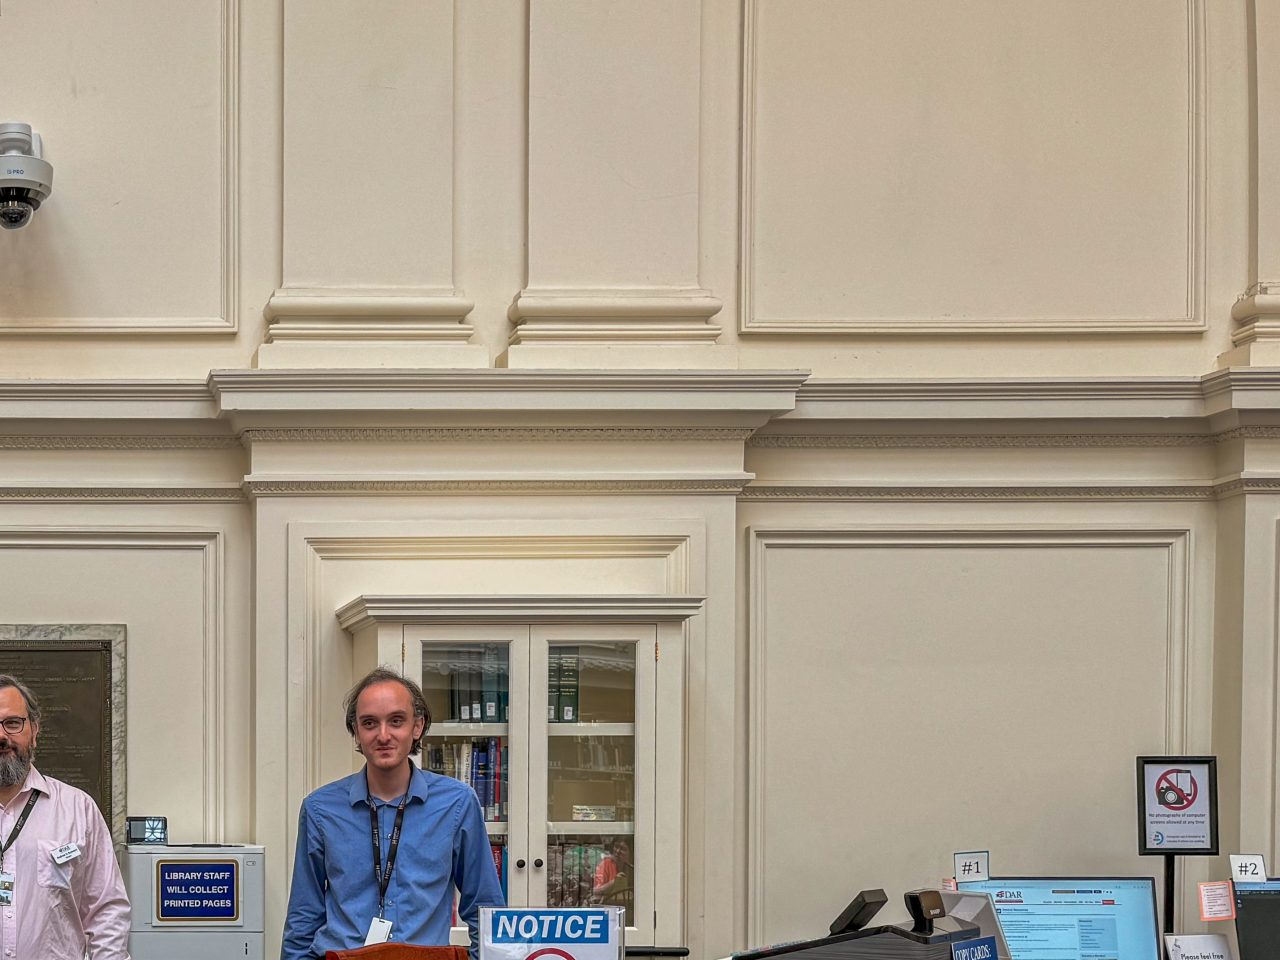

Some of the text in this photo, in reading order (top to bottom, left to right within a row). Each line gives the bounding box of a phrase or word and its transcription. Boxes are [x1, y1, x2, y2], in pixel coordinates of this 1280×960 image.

[961, 861, 982, 875] #1
[1238, 862, 1259, 876] #2
[165, 872, 230, 880] LIBRARY STAFF
[167, 886, 228, 894] WILL COLLECT
[1005, 890, 1022, 899] DAR
[202, 900, 231, 908] PAGES
[497, 915, 604, 939] NOTICE
[970, 944, 992, 960] CARDS:
[1180, 952, 1224, 960] Please feel free
